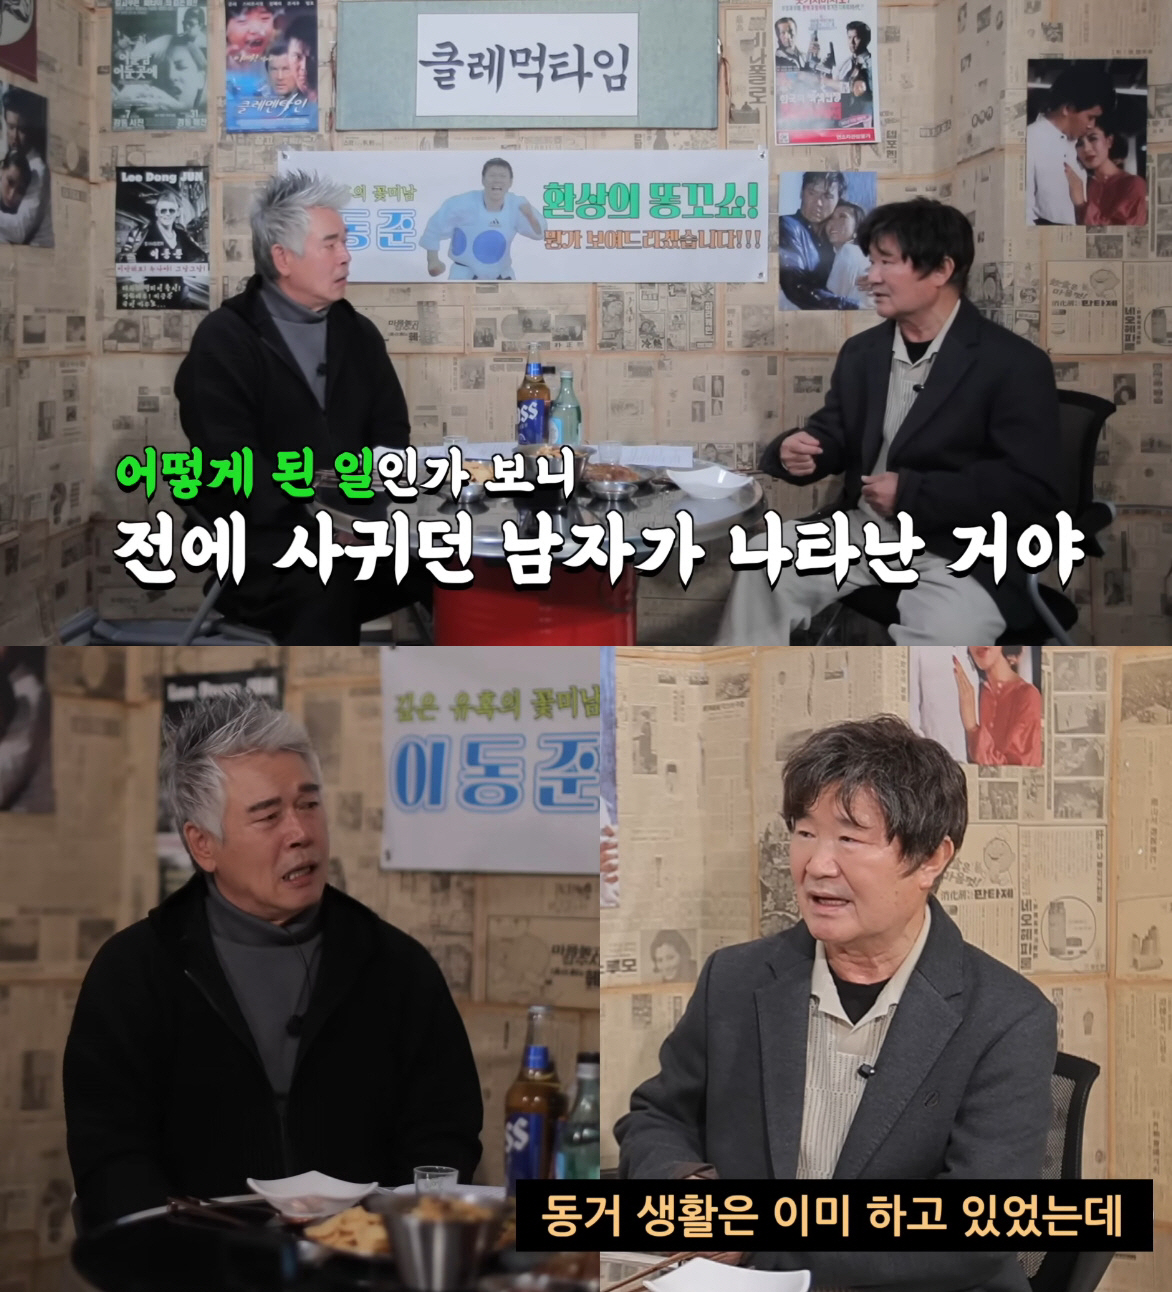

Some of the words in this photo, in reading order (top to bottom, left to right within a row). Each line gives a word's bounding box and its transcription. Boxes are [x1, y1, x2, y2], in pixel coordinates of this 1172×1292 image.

[418, 40, 630, 93] 클레먹타임
[121, 172, 143, 182] Lee
[145, 172, 178, 184] Dong
[180, 172, 204, 182] JUN
[372, 184, 418, 203] 꽃미남
[543, 182, 640, 220] 환상의
[649, 182, 759, 220] 똥꼬쇼!
[586, 229, 760, 250] 보여드리겠습니다!!!
[450, 688, 522, 721] 유혹의
[530, 684, 600, 721] 꽃미남
[389, 731, 600, 813] 이동준
